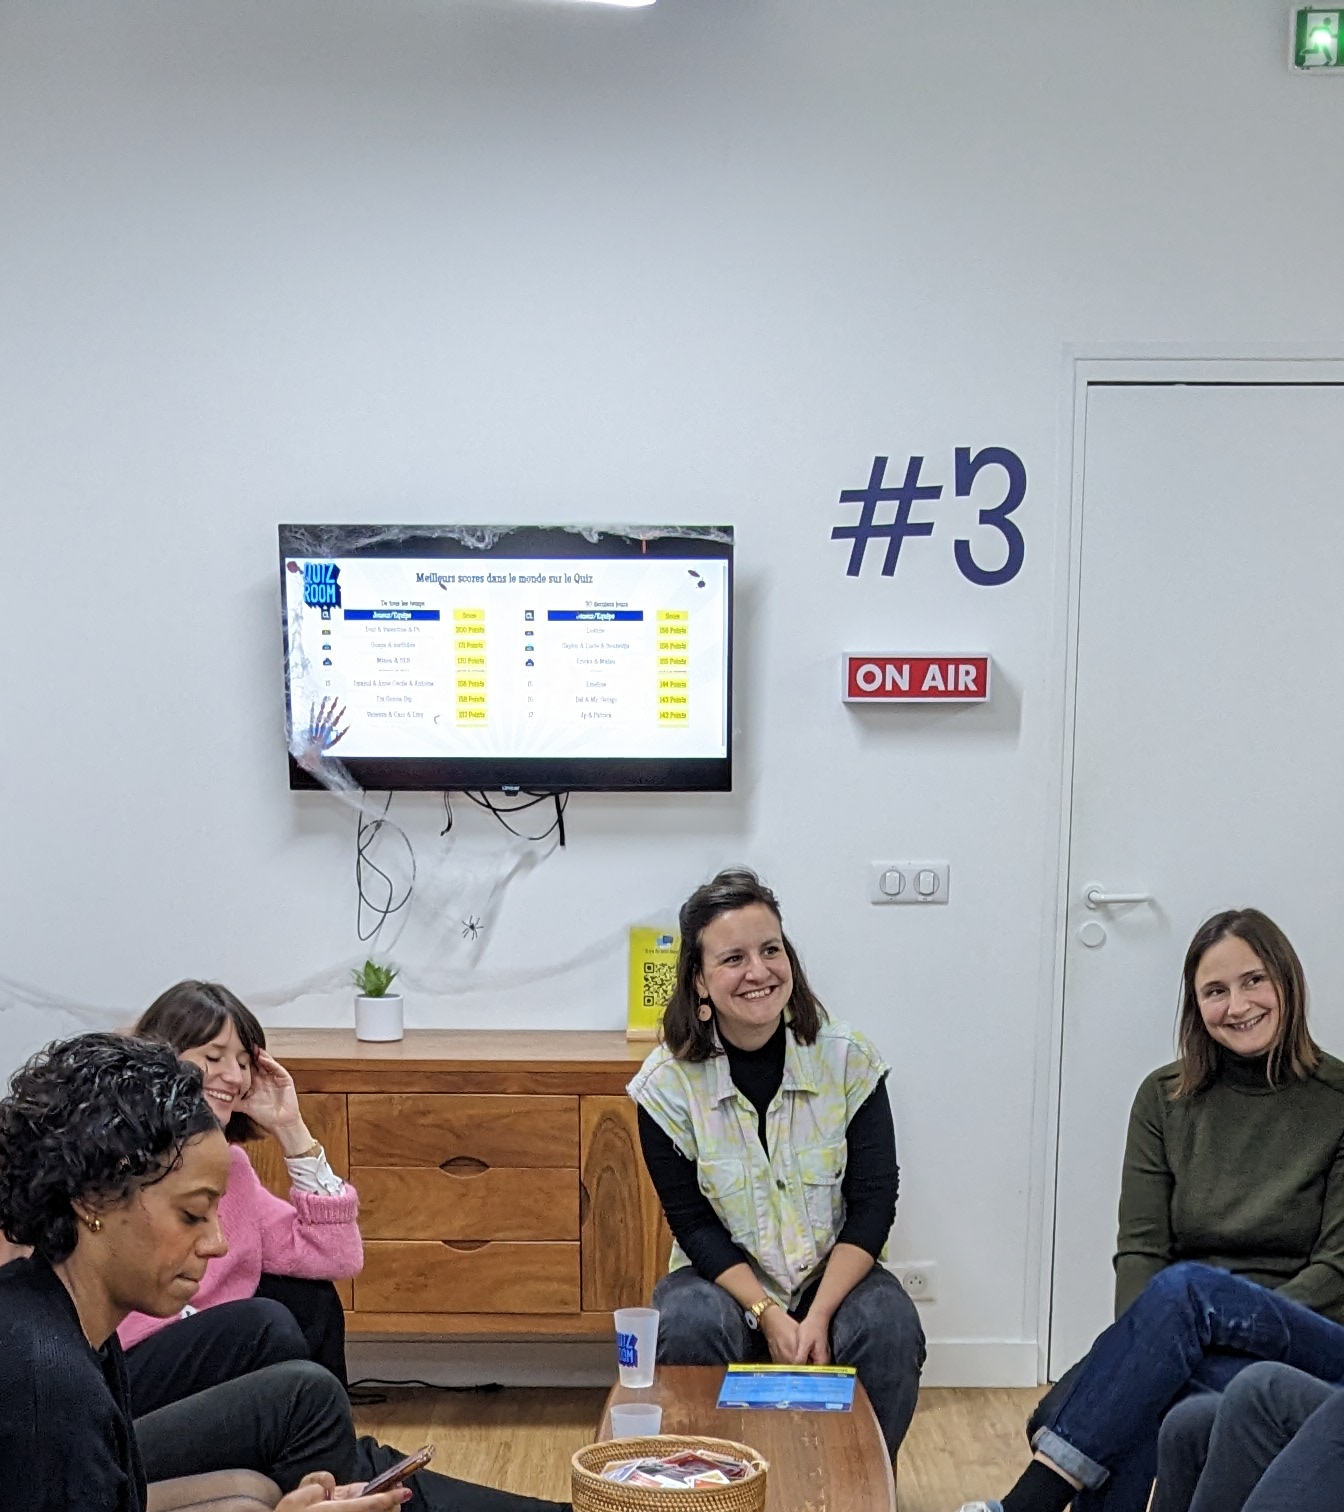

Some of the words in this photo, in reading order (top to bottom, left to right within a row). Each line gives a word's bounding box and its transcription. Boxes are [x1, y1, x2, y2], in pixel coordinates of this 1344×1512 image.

[830, 446, 1027, 586] #3
[304, 562, 337, 584] QUIZ
[416, 572, 456, 584] Meilleurs
[458, 575, 484, 584] scores
[487, 573, 506, 584] dans
[508, 573, 517, 584] le
[519, 573, 546, 584] monde
[549, 575, 562, 584] sur
[564, 573, 572, 584] le
[573, 573, 594, 585] Quiz
[304, 584, 337, 604] ROOM
[856, 664, 909, 691] ON
[921, 665, 977, 691] AIR
